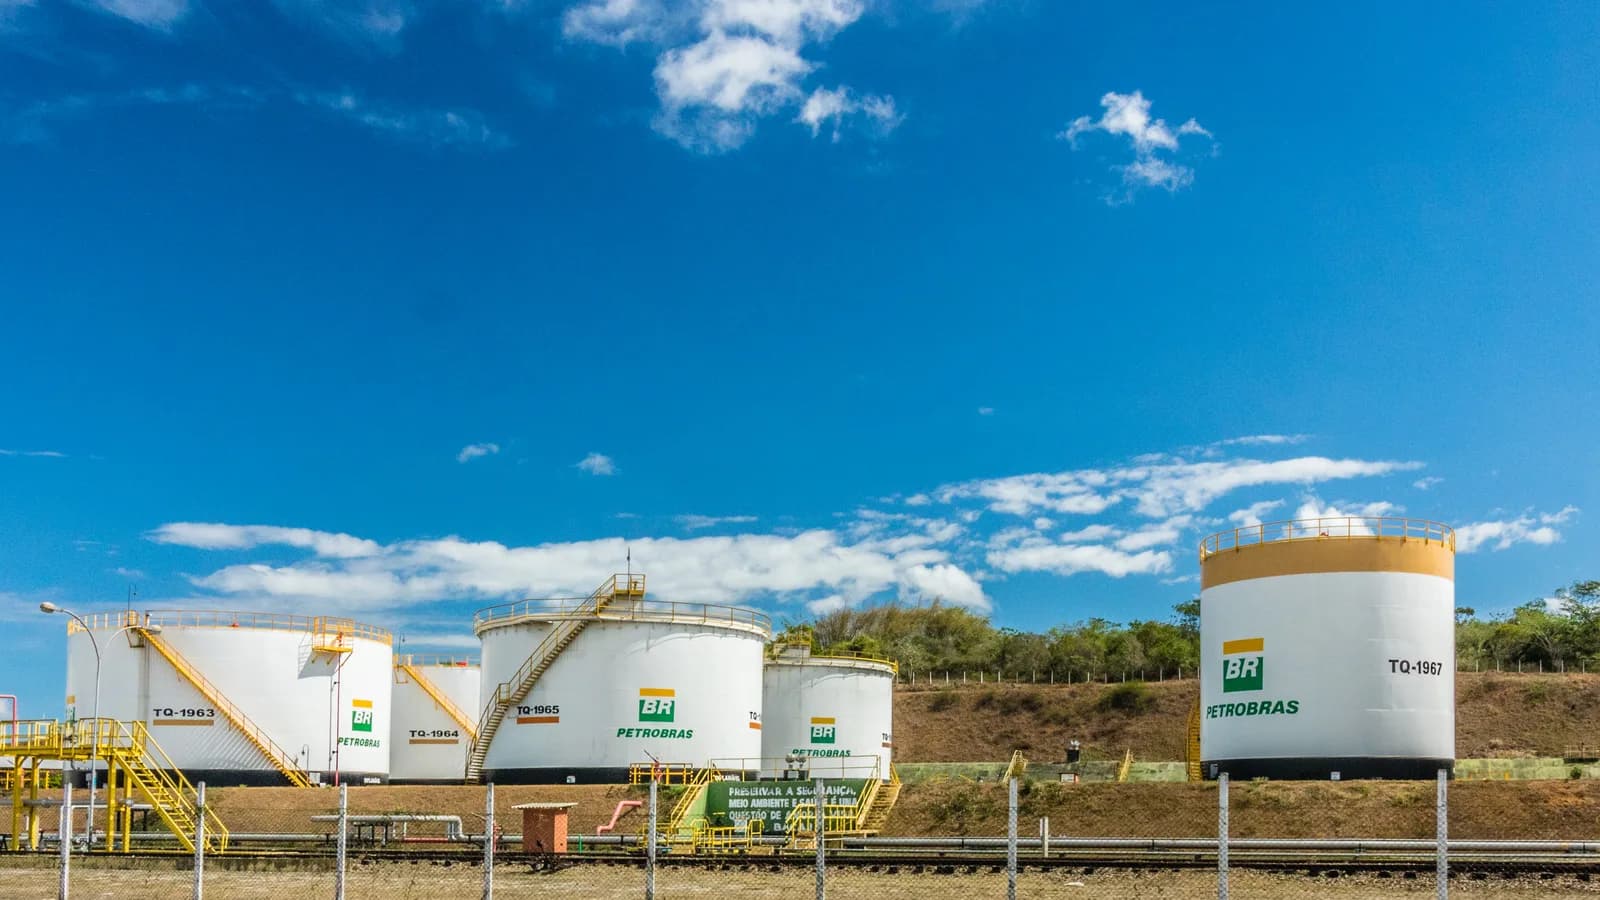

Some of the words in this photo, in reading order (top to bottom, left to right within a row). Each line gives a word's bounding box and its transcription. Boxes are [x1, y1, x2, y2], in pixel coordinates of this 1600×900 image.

[1225, 657, 1260, 680] BR
[1388, 659, 1443, 676] TQ-1967
[517, 705, 560, 715] TQ-1965
[641, 699, 673, 715] BR
[1206, 700, 1300, 719] PETROBRAS
[153, 708, 215, 718] TQ-1963
[409, 730, 459, 738] TQ-1964
[616, 728, 694, 739] PETROBRAS
[812, 727, 834, 738] BR
[337, 737, 380, 748] PETROBRAS
[786, 786, 794, 796] A
[770, 811, 782, 820] DE
